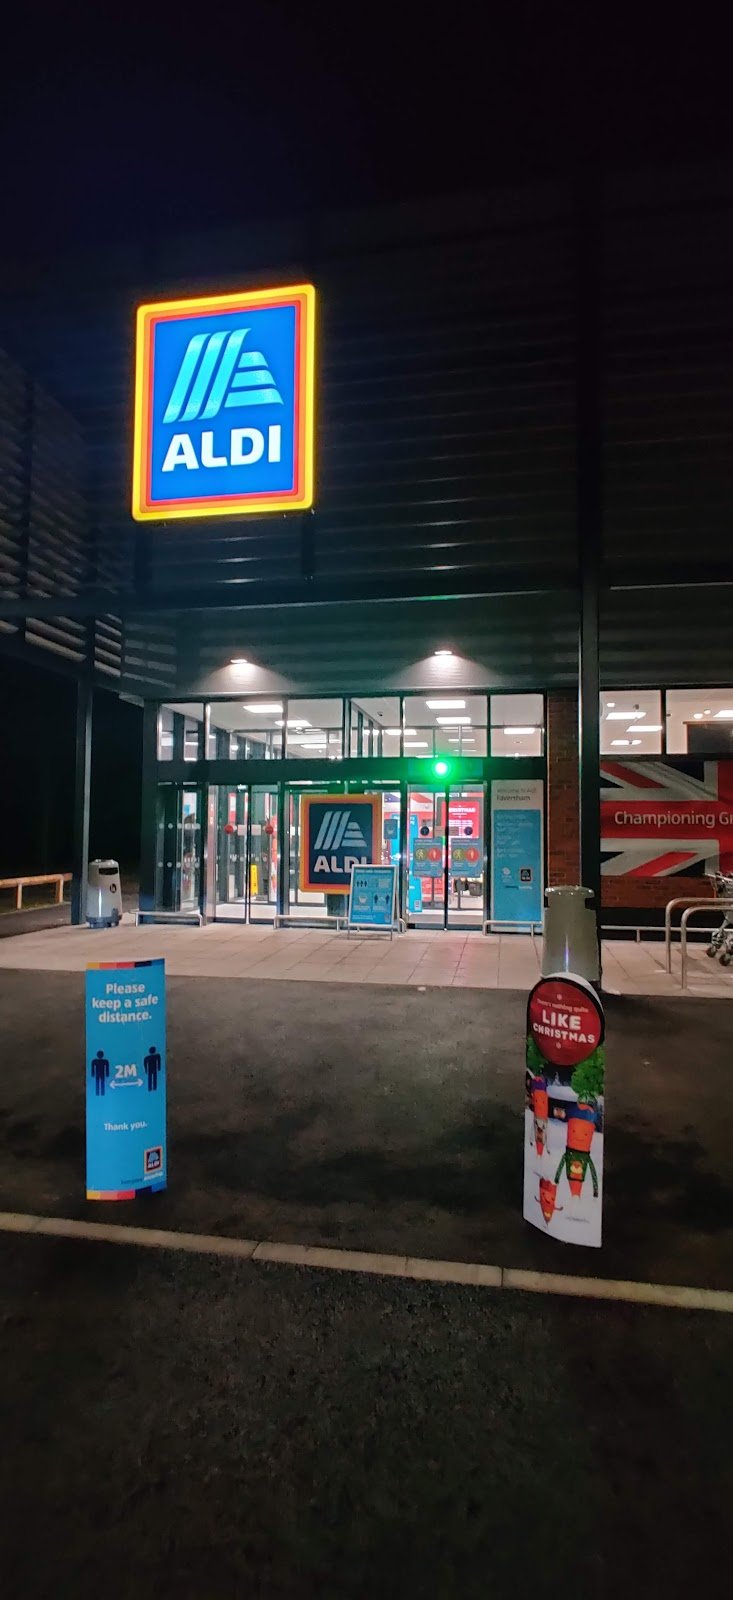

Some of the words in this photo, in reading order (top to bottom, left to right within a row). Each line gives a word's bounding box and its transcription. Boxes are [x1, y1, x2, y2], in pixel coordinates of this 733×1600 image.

[161, 424, 281, 472] ALDI
[615, 811, 715, 829] Championing
[106, 983, 145, 994] Please
[92, 997, 121, 1011] keep
[124, 999, 132, 1008] a
[135, 994, 159, 1008] safe
[98, 1011, 152, 1023] distance.
[542, 1009, 581, 1030] LIKE
[533, 1023, 595, 1044] CHRISTMAS
[115, 1063, 137, 1078] 2M
[103, 1122, 129, 1131] Thank
